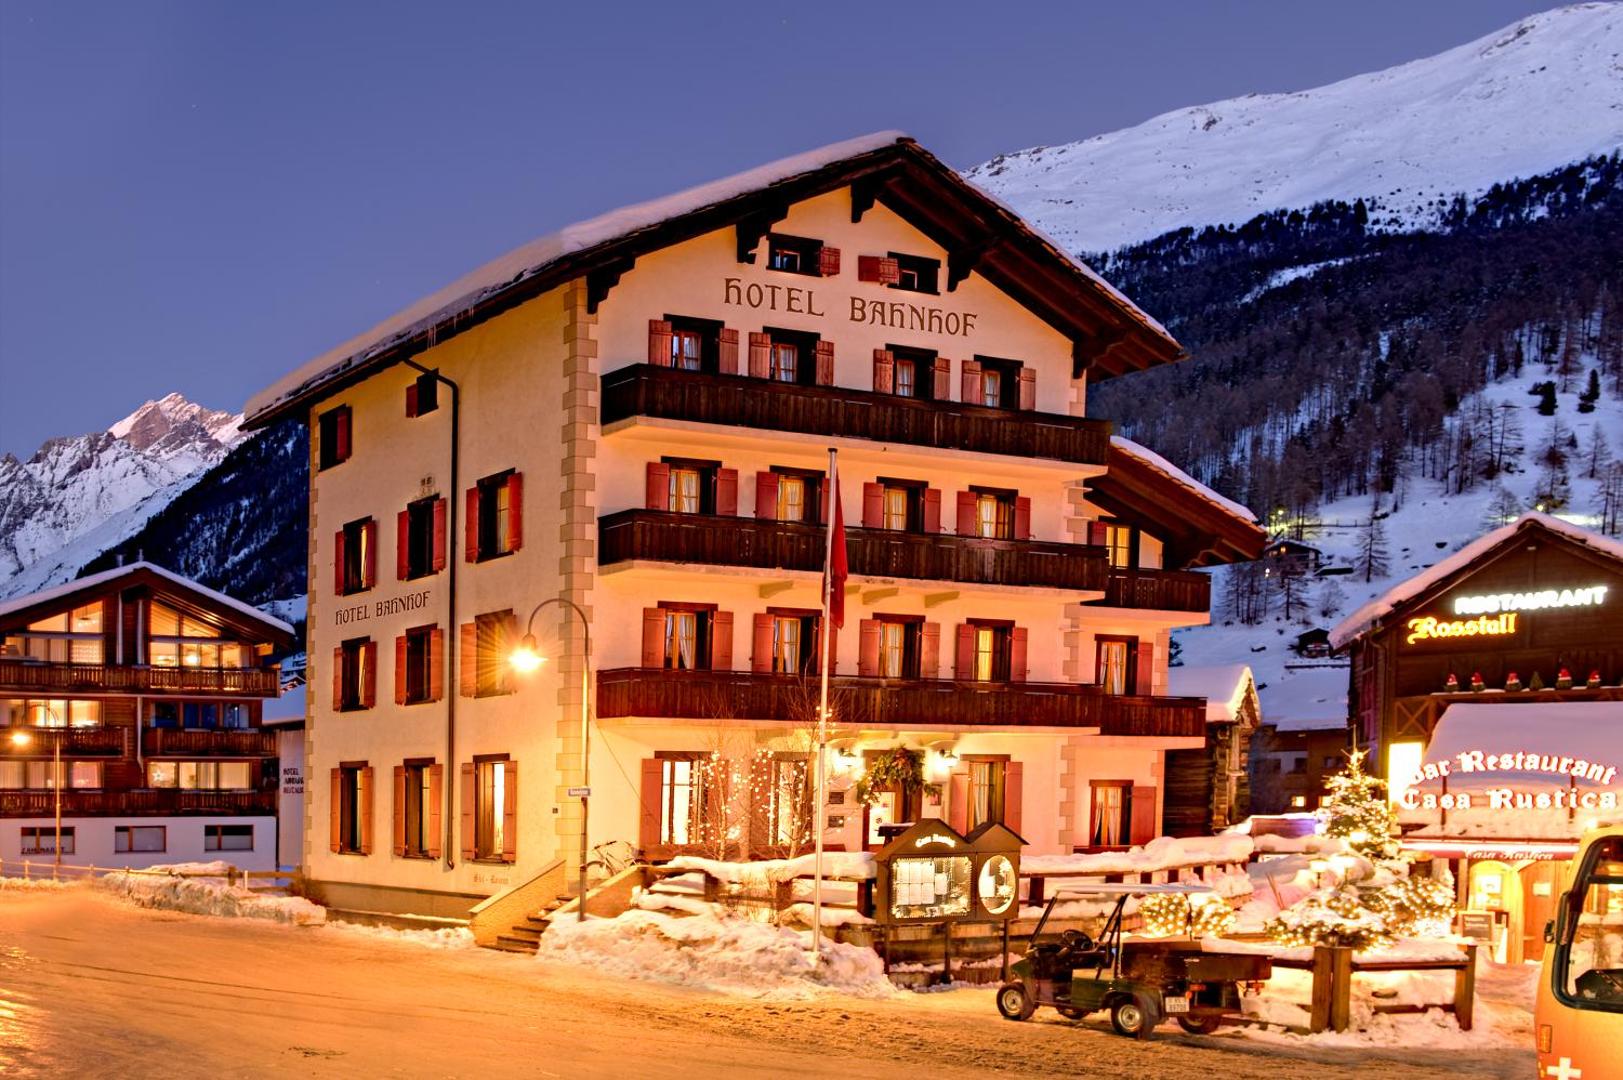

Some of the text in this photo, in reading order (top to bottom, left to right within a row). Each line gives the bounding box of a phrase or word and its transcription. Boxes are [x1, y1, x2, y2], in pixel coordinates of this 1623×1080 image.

[724, 278, 977, 337] HOTEL BAHNHOF
[335, 591, 431, 626] HOTEL BAHNHOF
[1454, 586, 1608, 615] RESTAURANT
[1455, 750, 1617, 786] Restaurant
[1400, 787, 1618, 811] Casa Rustica
